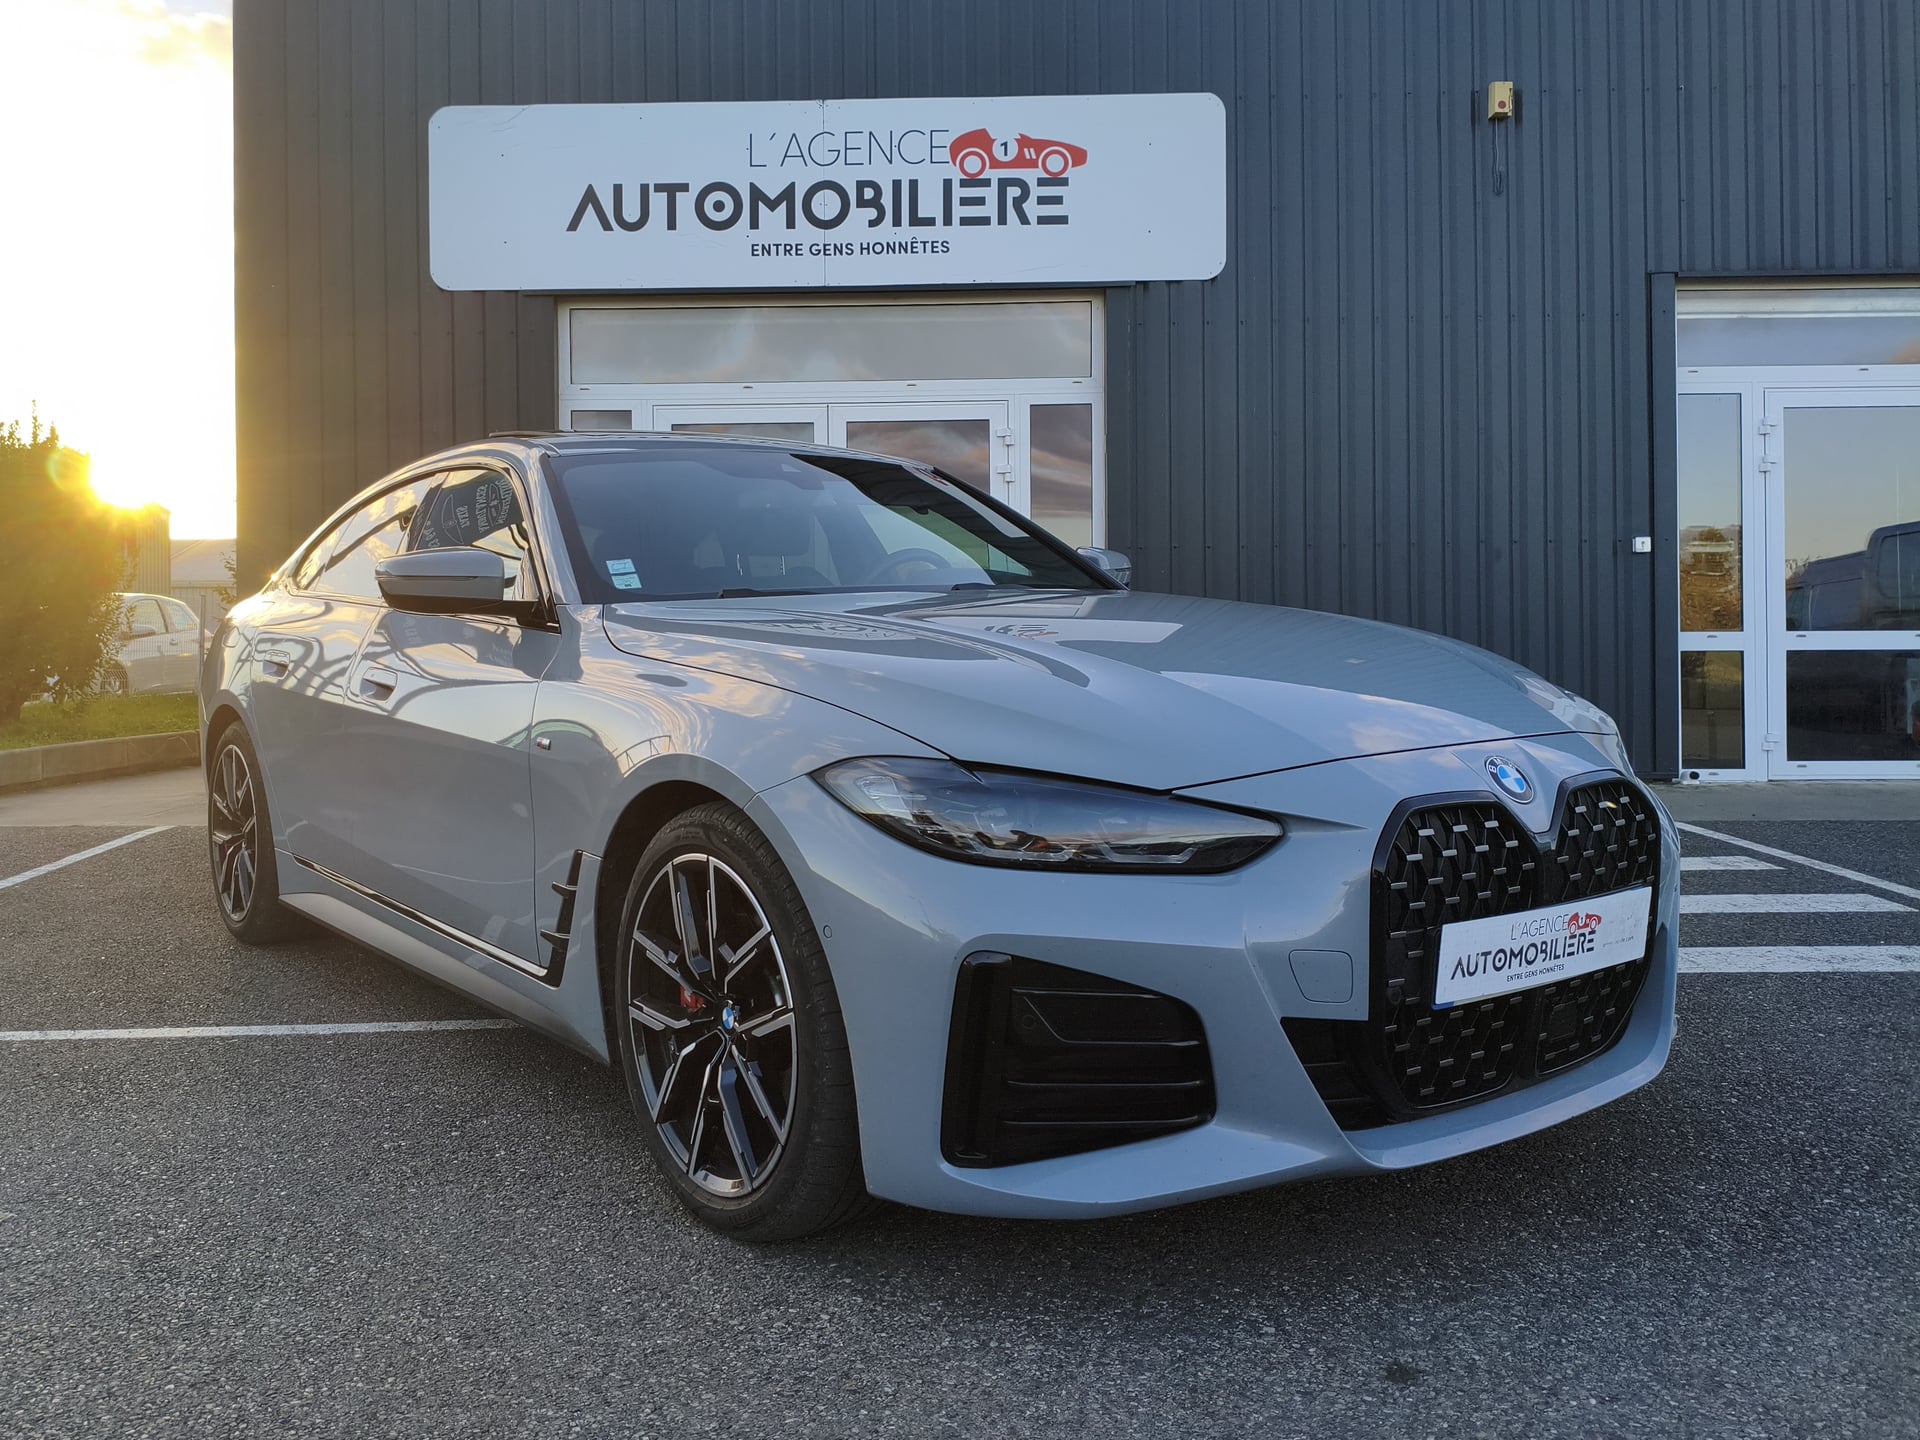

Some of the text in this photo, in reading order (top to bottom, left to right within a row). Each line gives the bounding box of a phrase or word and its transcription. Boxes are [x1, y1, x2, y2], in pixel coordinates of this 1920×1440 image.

[749, 129, 950, 168] L'AGENCE
[1000, 141, 1008, 157] 1
[566, 176, 1069, 232] AUTOMOBILIERE
[751, 237, 950, 257] ENTRE GENS HONNÊTES
[1450, 930, 1596, 980] AUTOMOBILIERE
[1506, 972, 1523, 982] ENTRE
[1524, 969, 1538, 979] GENS
